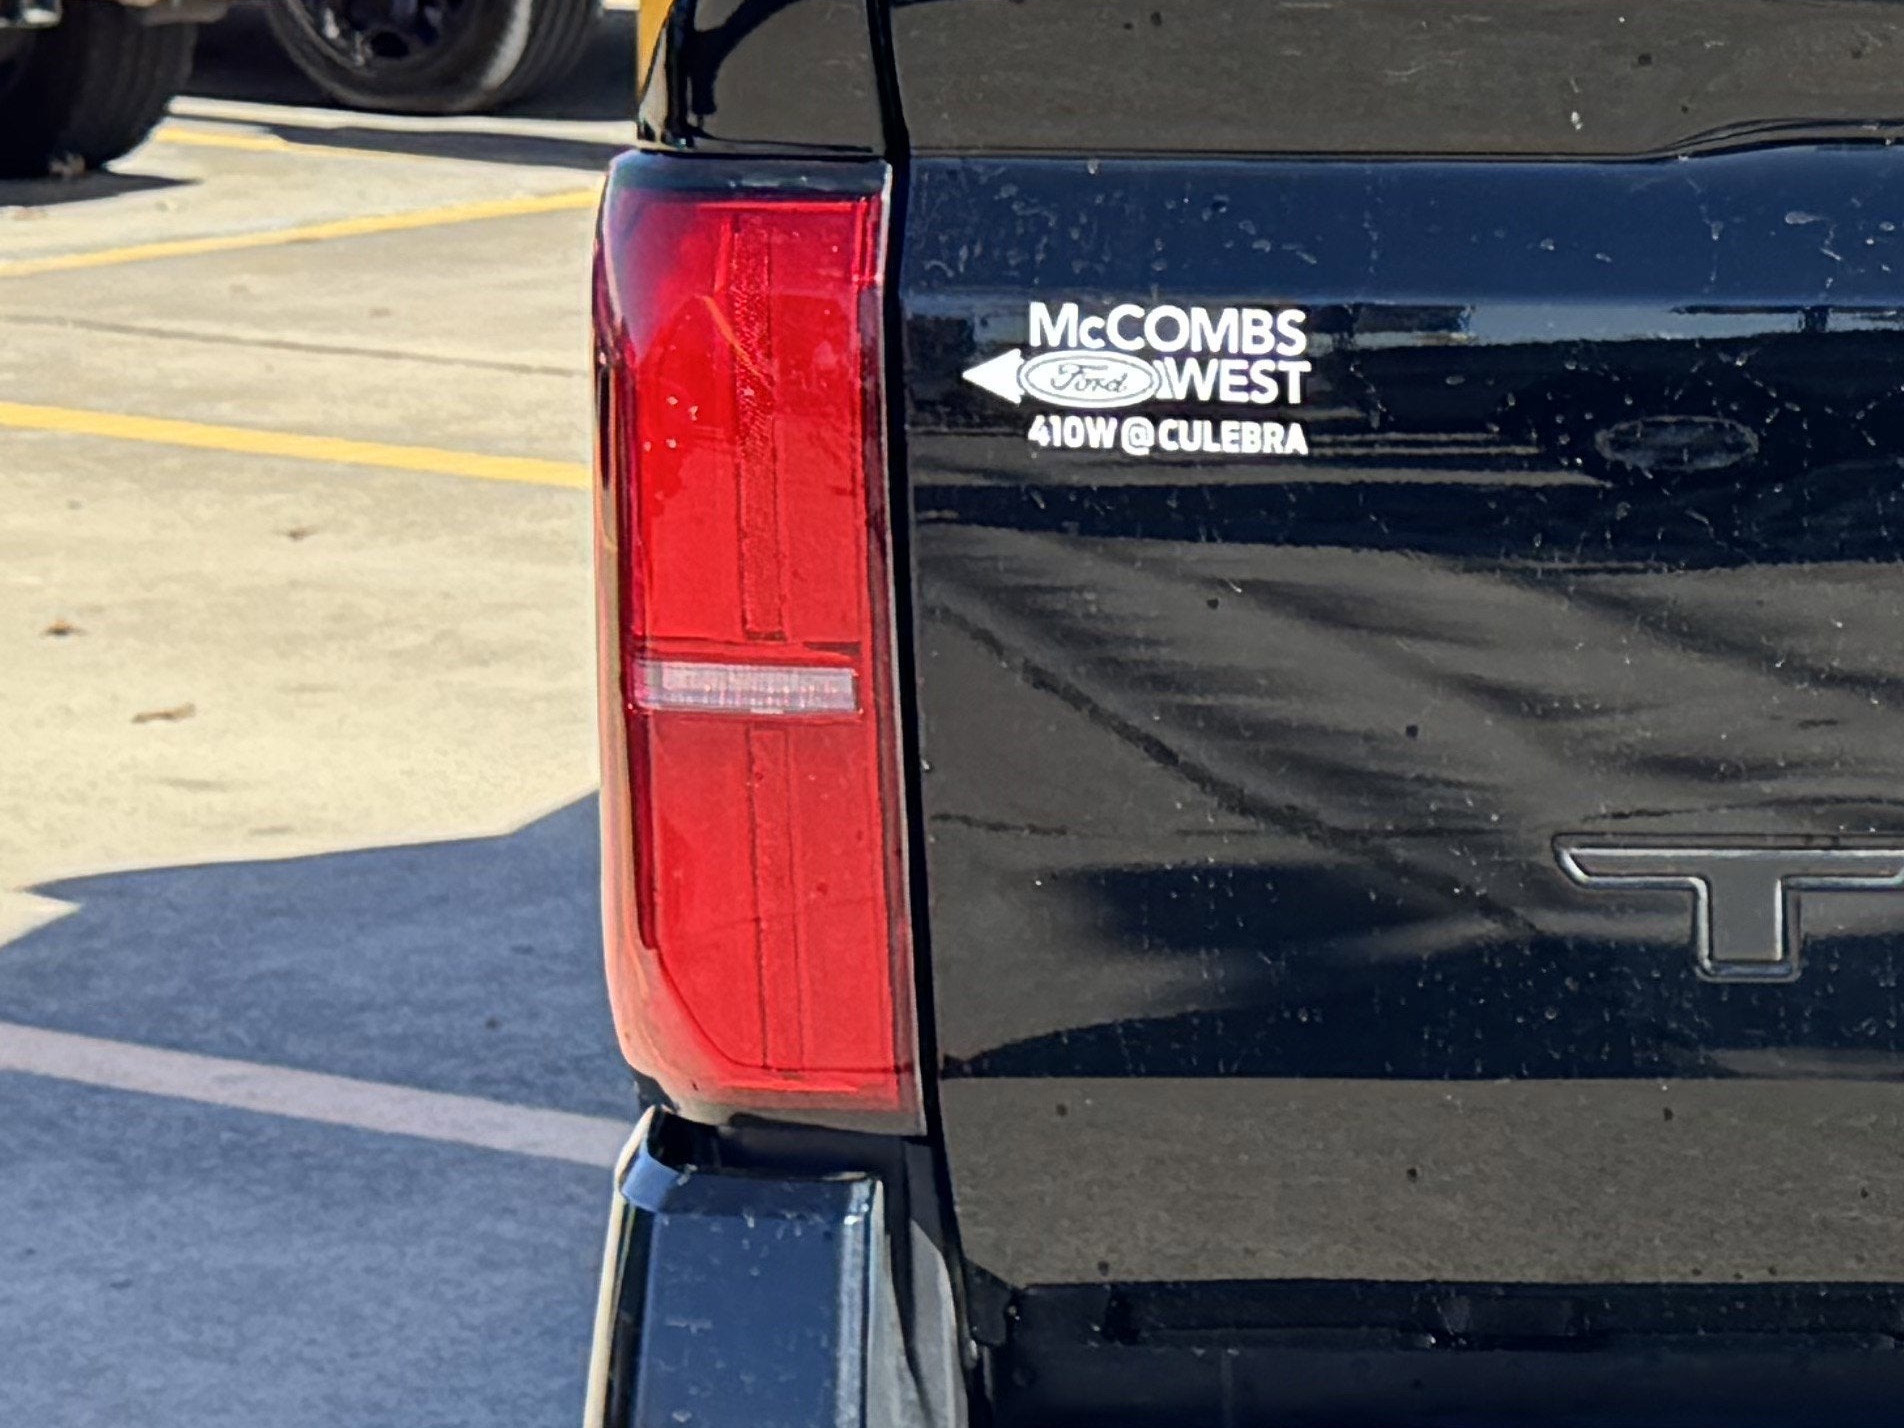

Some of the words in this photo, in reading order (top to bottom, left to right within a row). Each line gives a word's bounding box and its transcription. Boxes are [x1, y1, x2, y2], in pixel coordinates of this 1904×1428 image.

[1028, 301, 1308, 356] McCOMBS
[1050, 363, 1128, 393] Ford
[1164, 356, 1312, 404] WEST
